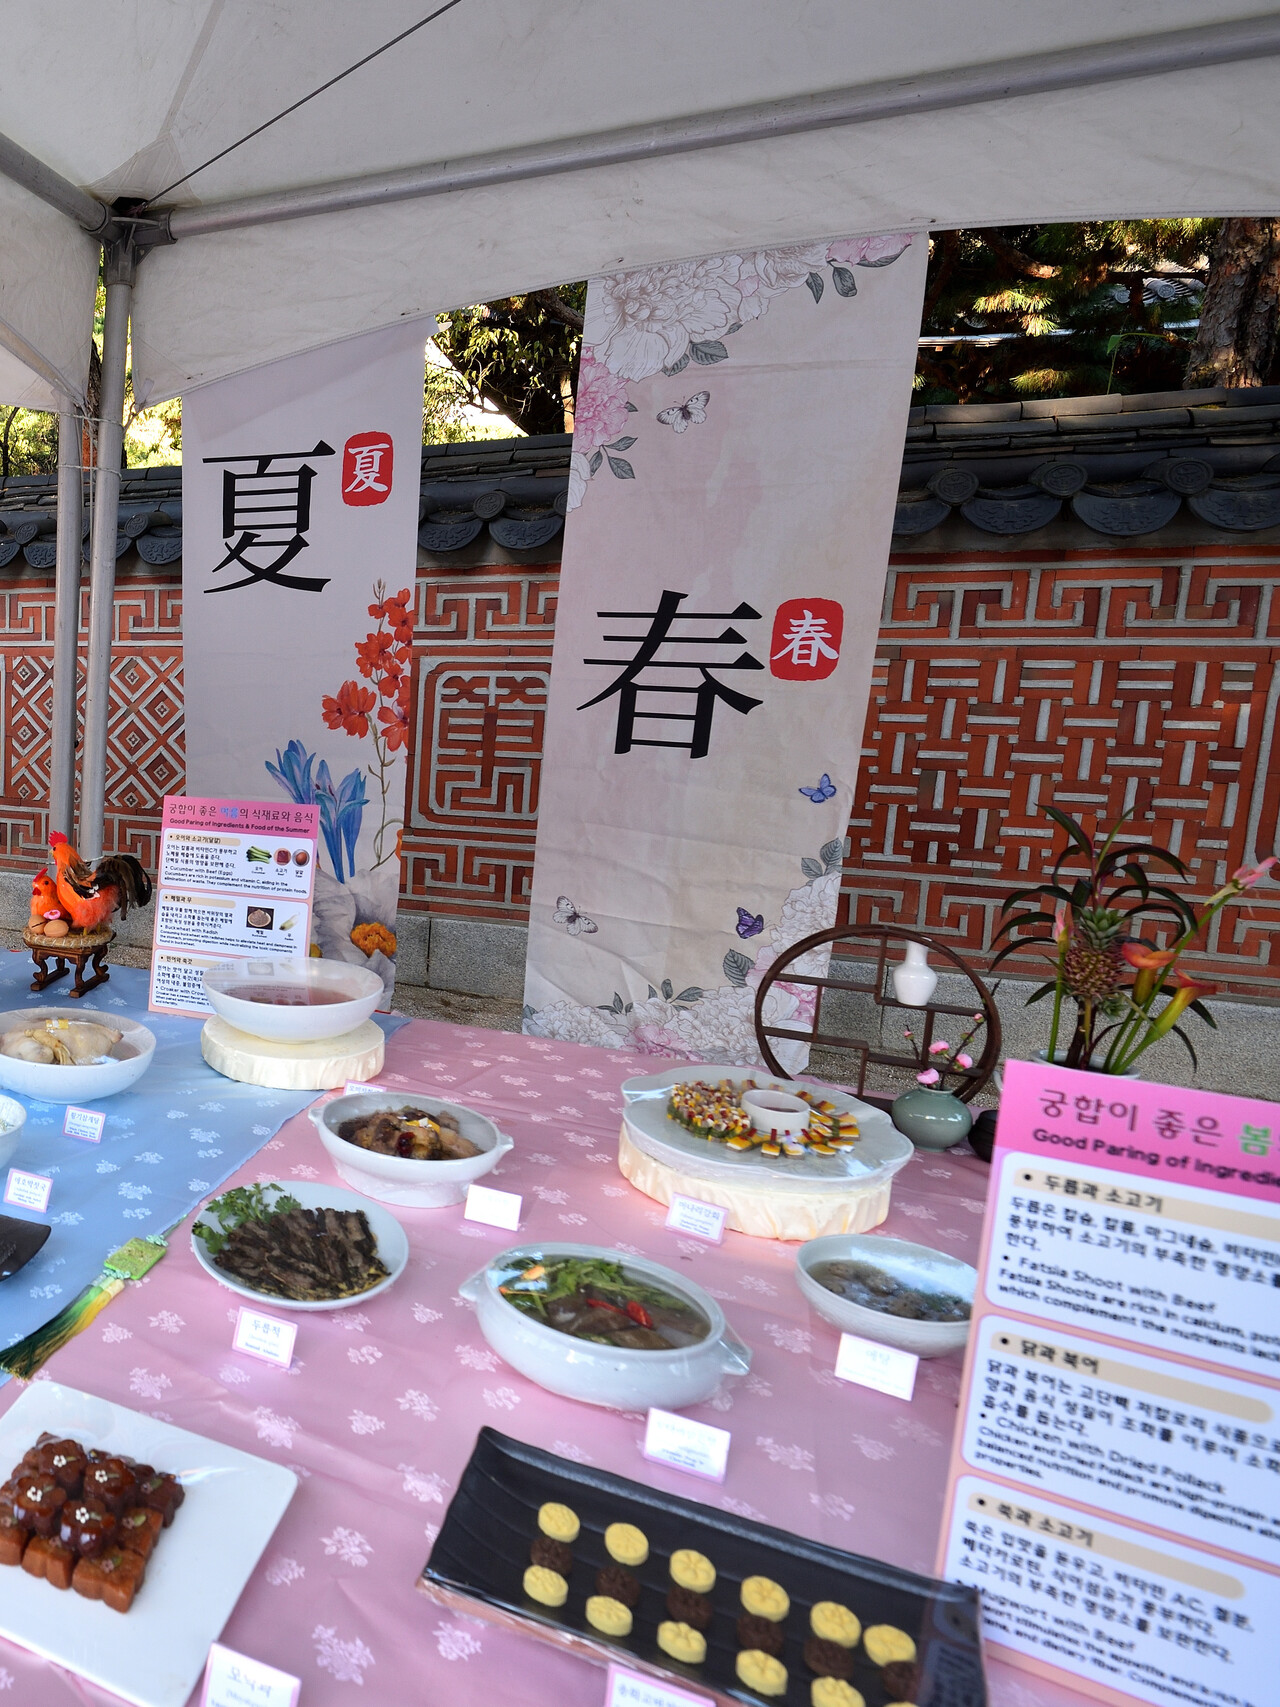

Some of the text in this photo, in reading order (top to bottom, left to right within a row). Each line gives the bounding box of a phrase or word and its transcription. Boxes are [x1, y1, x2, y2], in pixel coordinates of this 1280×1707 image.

[343, 444, 391, 493] 夏
[202, 440, 336, 594] 夏
[770, 611, 840, 668] 春
[577, 589, 765, 759] 春
[168, 803, 313, 824] 궁합이 좋은 여름의 식재료와 음식
[185, 818, 204, 827] Paring
[211, 820, 244, 830] Ingredients
[285, 825, 310, 834] Summer
[1037, 1088, 1280, 1159] 궁합이 좋은 봄
[1032, 1127, 1088, 1150] Good
[1091, 1138, 1161, 1166] Paring
[1164, 1153, 1189, 1169] of
[678, 1201, 720, 1220] 미나리강회
[1045, 1175, 1162, 1212] 두릅과 소고기
[1080, 1231, 1146, 1256] 소고기의
[1154, 1247, 1206, 1271] 부족한
[999, 1268, 1042, 1287] Fatsia
[1046, 1279, 1097, 1300] Shoots
[1101, 1295, 1126, 1308] are
[1130, 1301, 1159, 1316] rich
[1164, 1310, 1177, 1320] in
[1019, 1257, 1215, 1314] Fatsia Shoot with Beef
[998, 1283, 1039, 1300] which
[1043, 1295, 1136, 1325] complement
[1141, 1319, 1167, 1333] the
[1020, 1340, 1098, 1373] 닭과 북어
[996, 1415, 1224, 1494] Chicken with Dried Pollack
[1039, 1516, 1092, 1546] 소고기
[961, 1554, 1021, 1586] 소고기의
[1053, 1614, 1088, 1635] with
[1094, 1628, 1134, 1653] Beef
